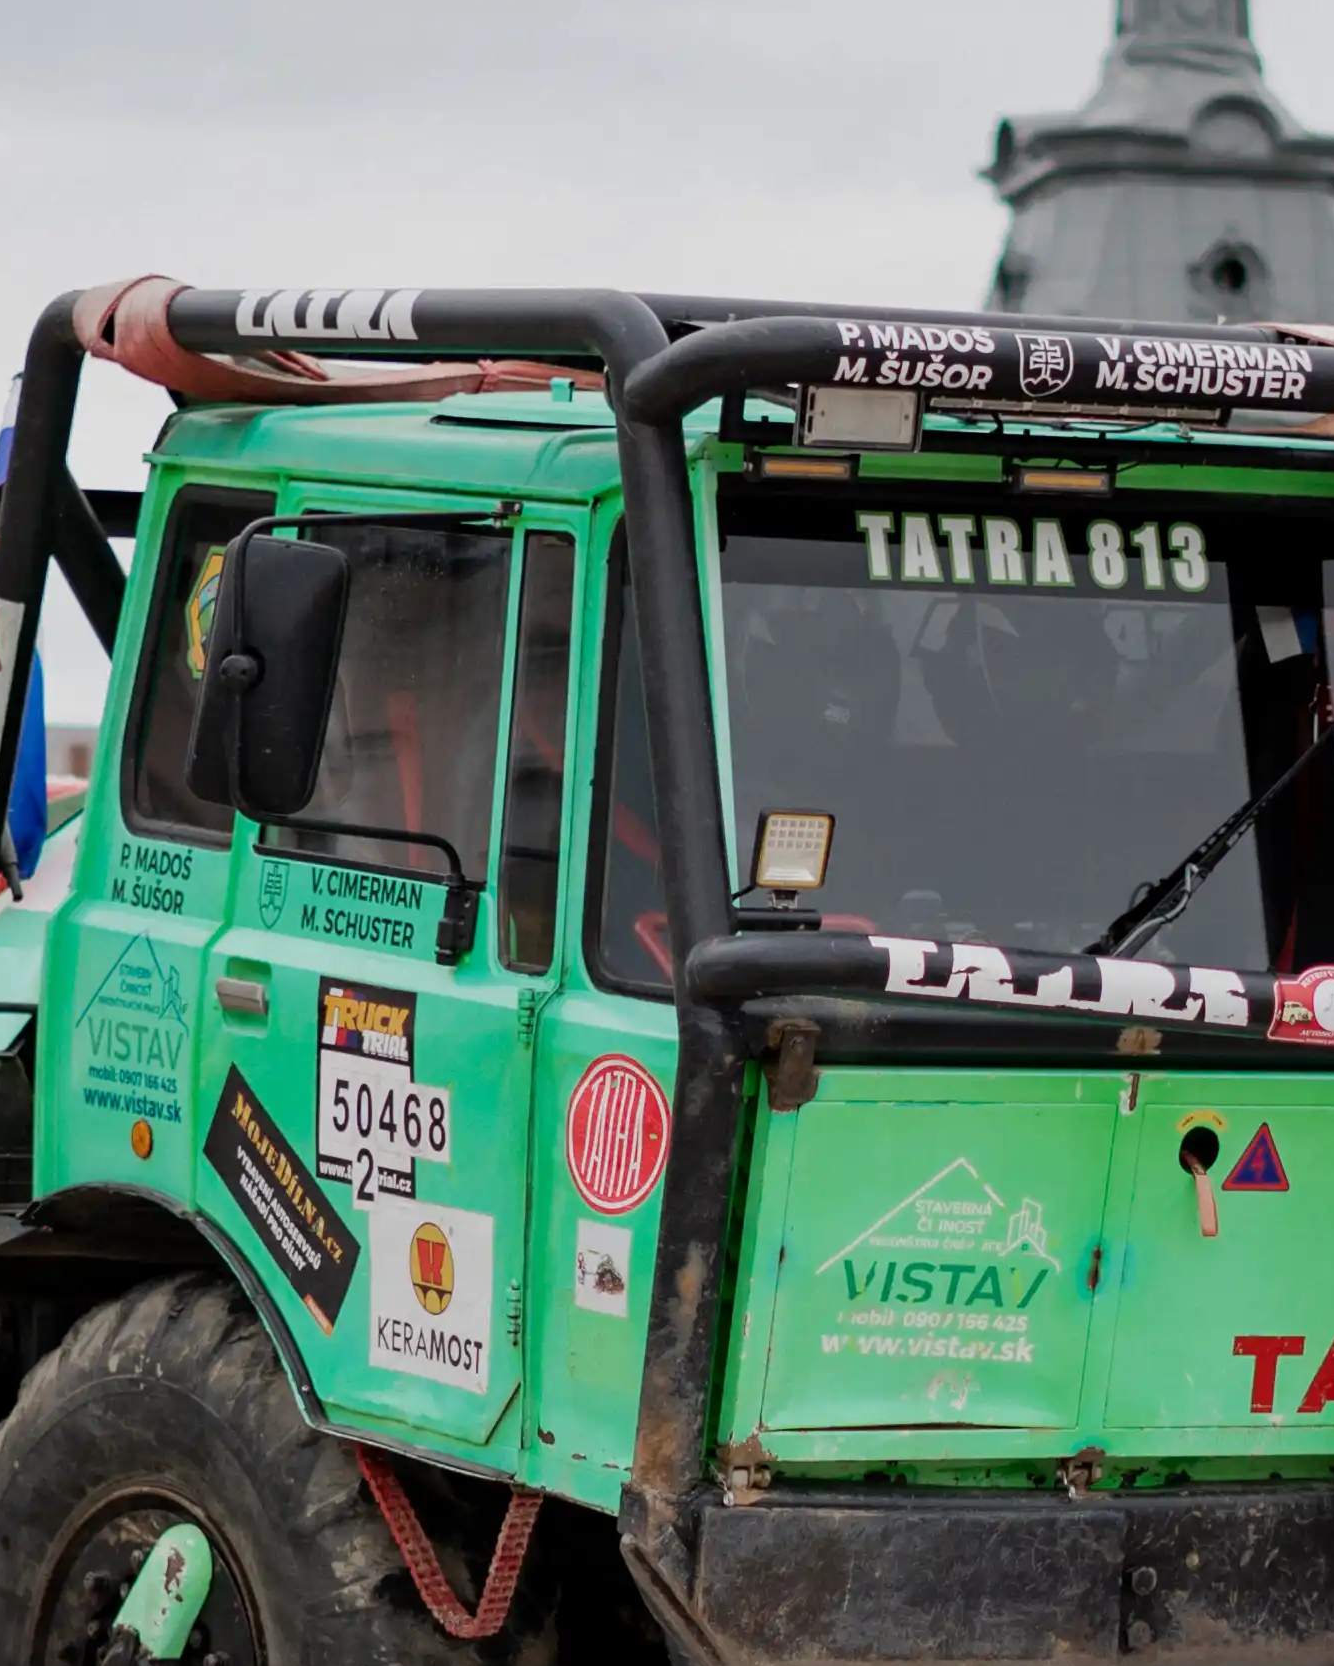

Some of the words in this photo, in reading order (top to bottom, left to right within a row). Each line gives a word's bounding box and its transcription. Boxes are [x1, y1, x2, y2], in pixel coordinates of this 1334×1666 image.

[836, 321, 864, 348] P.
[868, 324, 995, 354] MADOŠ
[1134, 340, 1313, 372] CIMERMAN
[834, 356, 868, 383] M.
[876, 351, 993, 390] ŠUŠOR
[1095, 361, 1129, 391] M.
[1134, 365, 1306, 400] SCHUSTER
[856, 511, 1075, 588] TATRA
[1086, 519, 1210, 594] 813
[121, 843, 130, 868] P.
[135, 845, 194, 881] MADOŠ
[112, 878, 127, 903] M.
[131, 872, 185, 915] ŠUŠOR
[311, 867, 325, 895] V.
[327, 870, 423, 911] CIMERMAN
[301, 904, 319, 932] M.
[323, 908, 415, 949] SCHUSTER
[324, 994, 410, 1036] TRUCK
[88, 1017, 183, 1070] VISTAV
[362, 1030, 409, 1061] TRIAL
[83, 1088, 182, 1123] www.vistav.sk
[332, 1078, 446, 1152] 50468
[581, 1070, 647, 1198] TATRA
[356, 1148, 375, 1202] 2
[267, 1218, 282, 1241] PRO
[991, 1314, 1028, 1333] 425
[378, 1316, 483, 1374] KERAMOST
